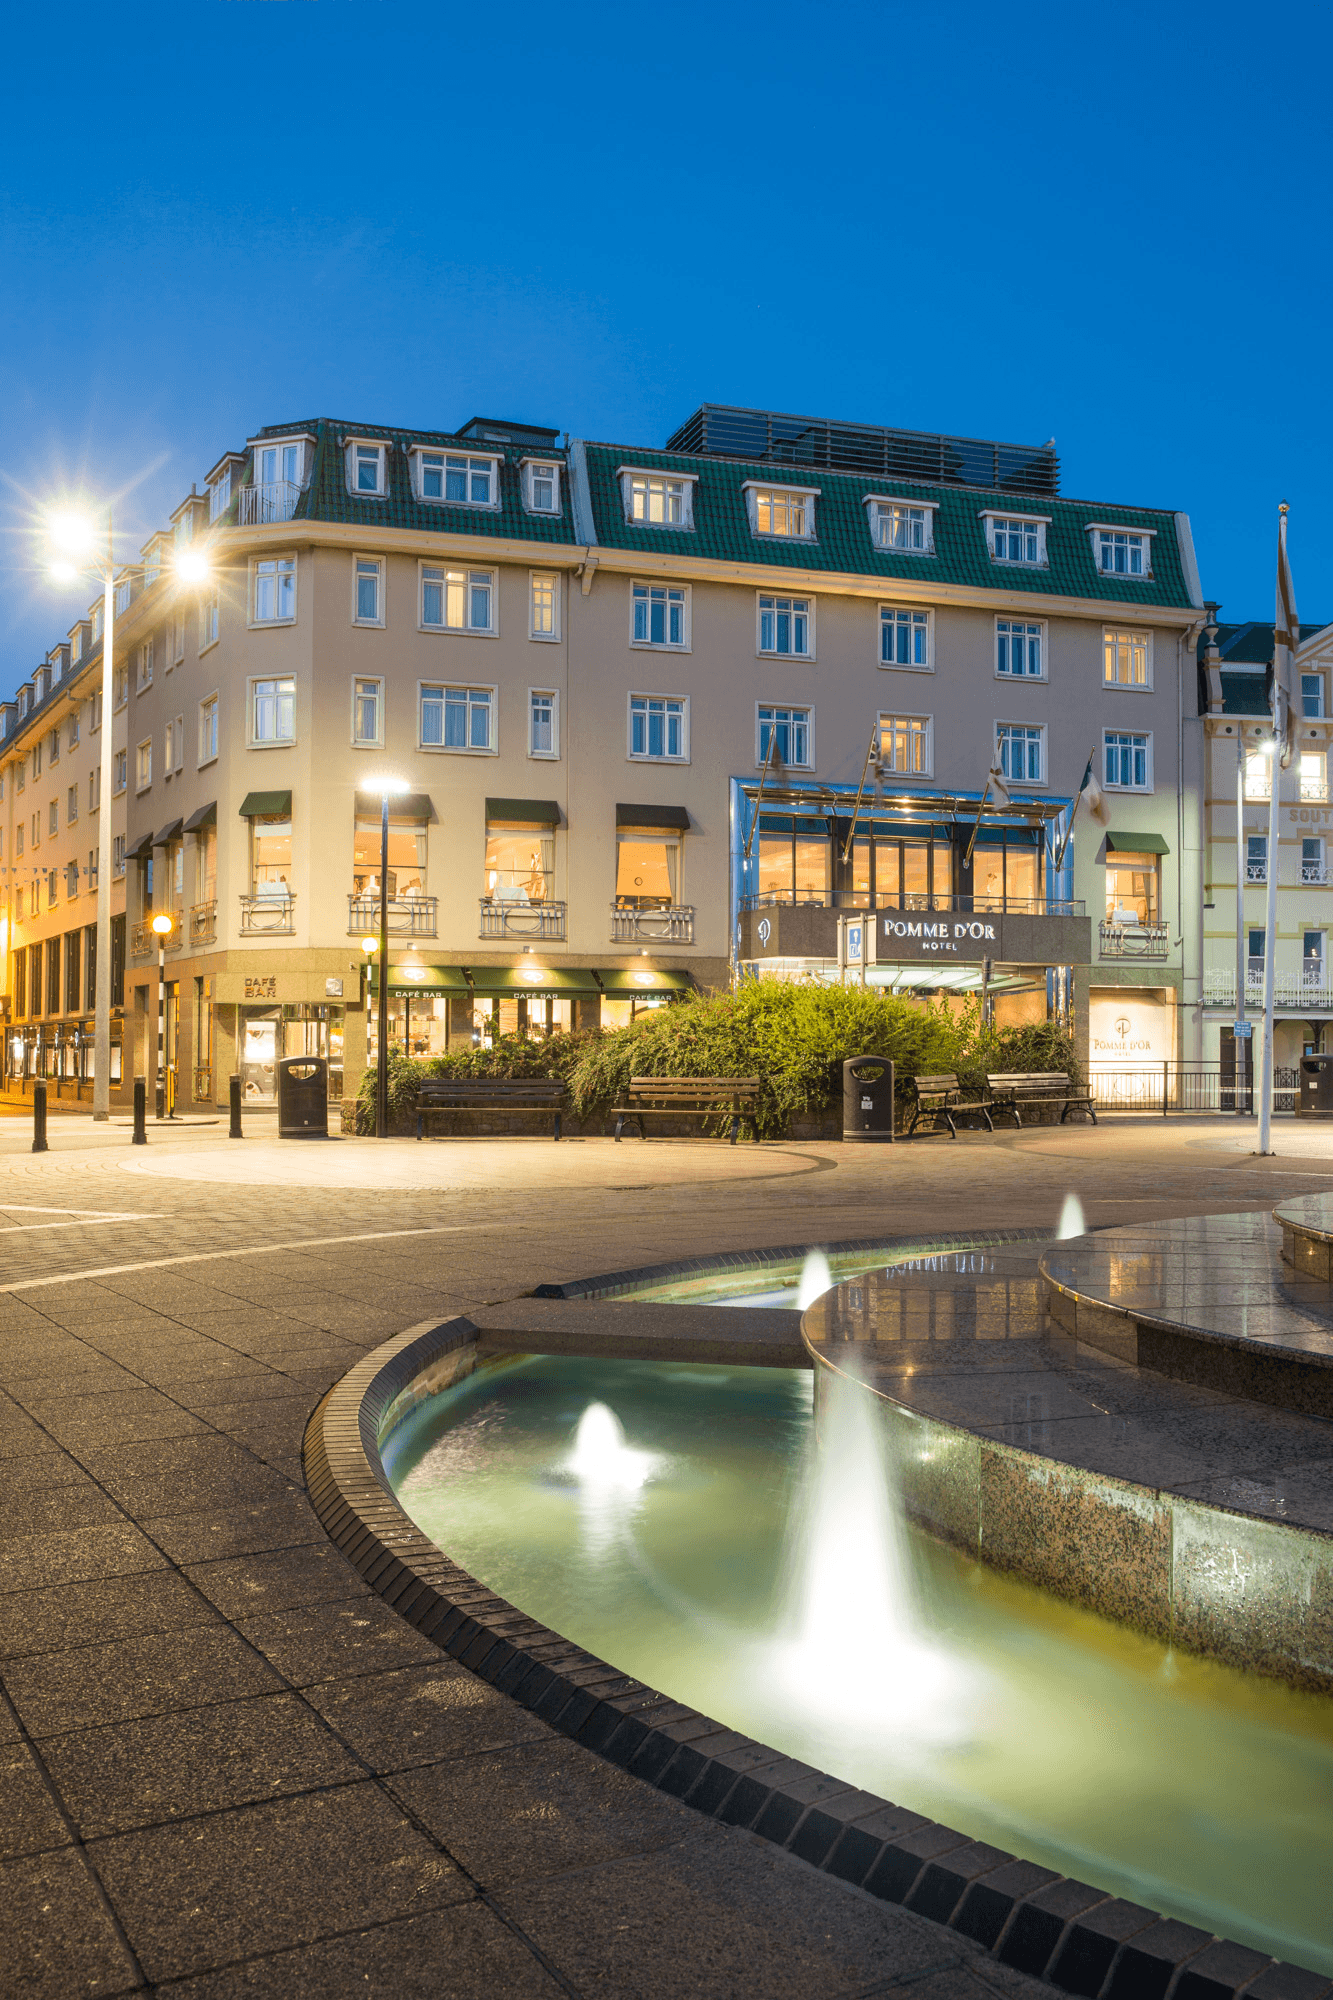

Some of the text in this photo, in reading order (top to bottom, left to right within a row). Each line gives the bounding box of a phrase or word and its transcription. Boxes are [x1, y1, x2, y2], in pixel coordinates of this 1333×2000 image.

[1290, 809, 1331, 823] SOUT
[884, 919, 949, 938] POMME
[922, 941, 957, 951] HOTEL
[246, 975, 276, 986] CAFÉ
[245, 987, 276, 998] BAR
